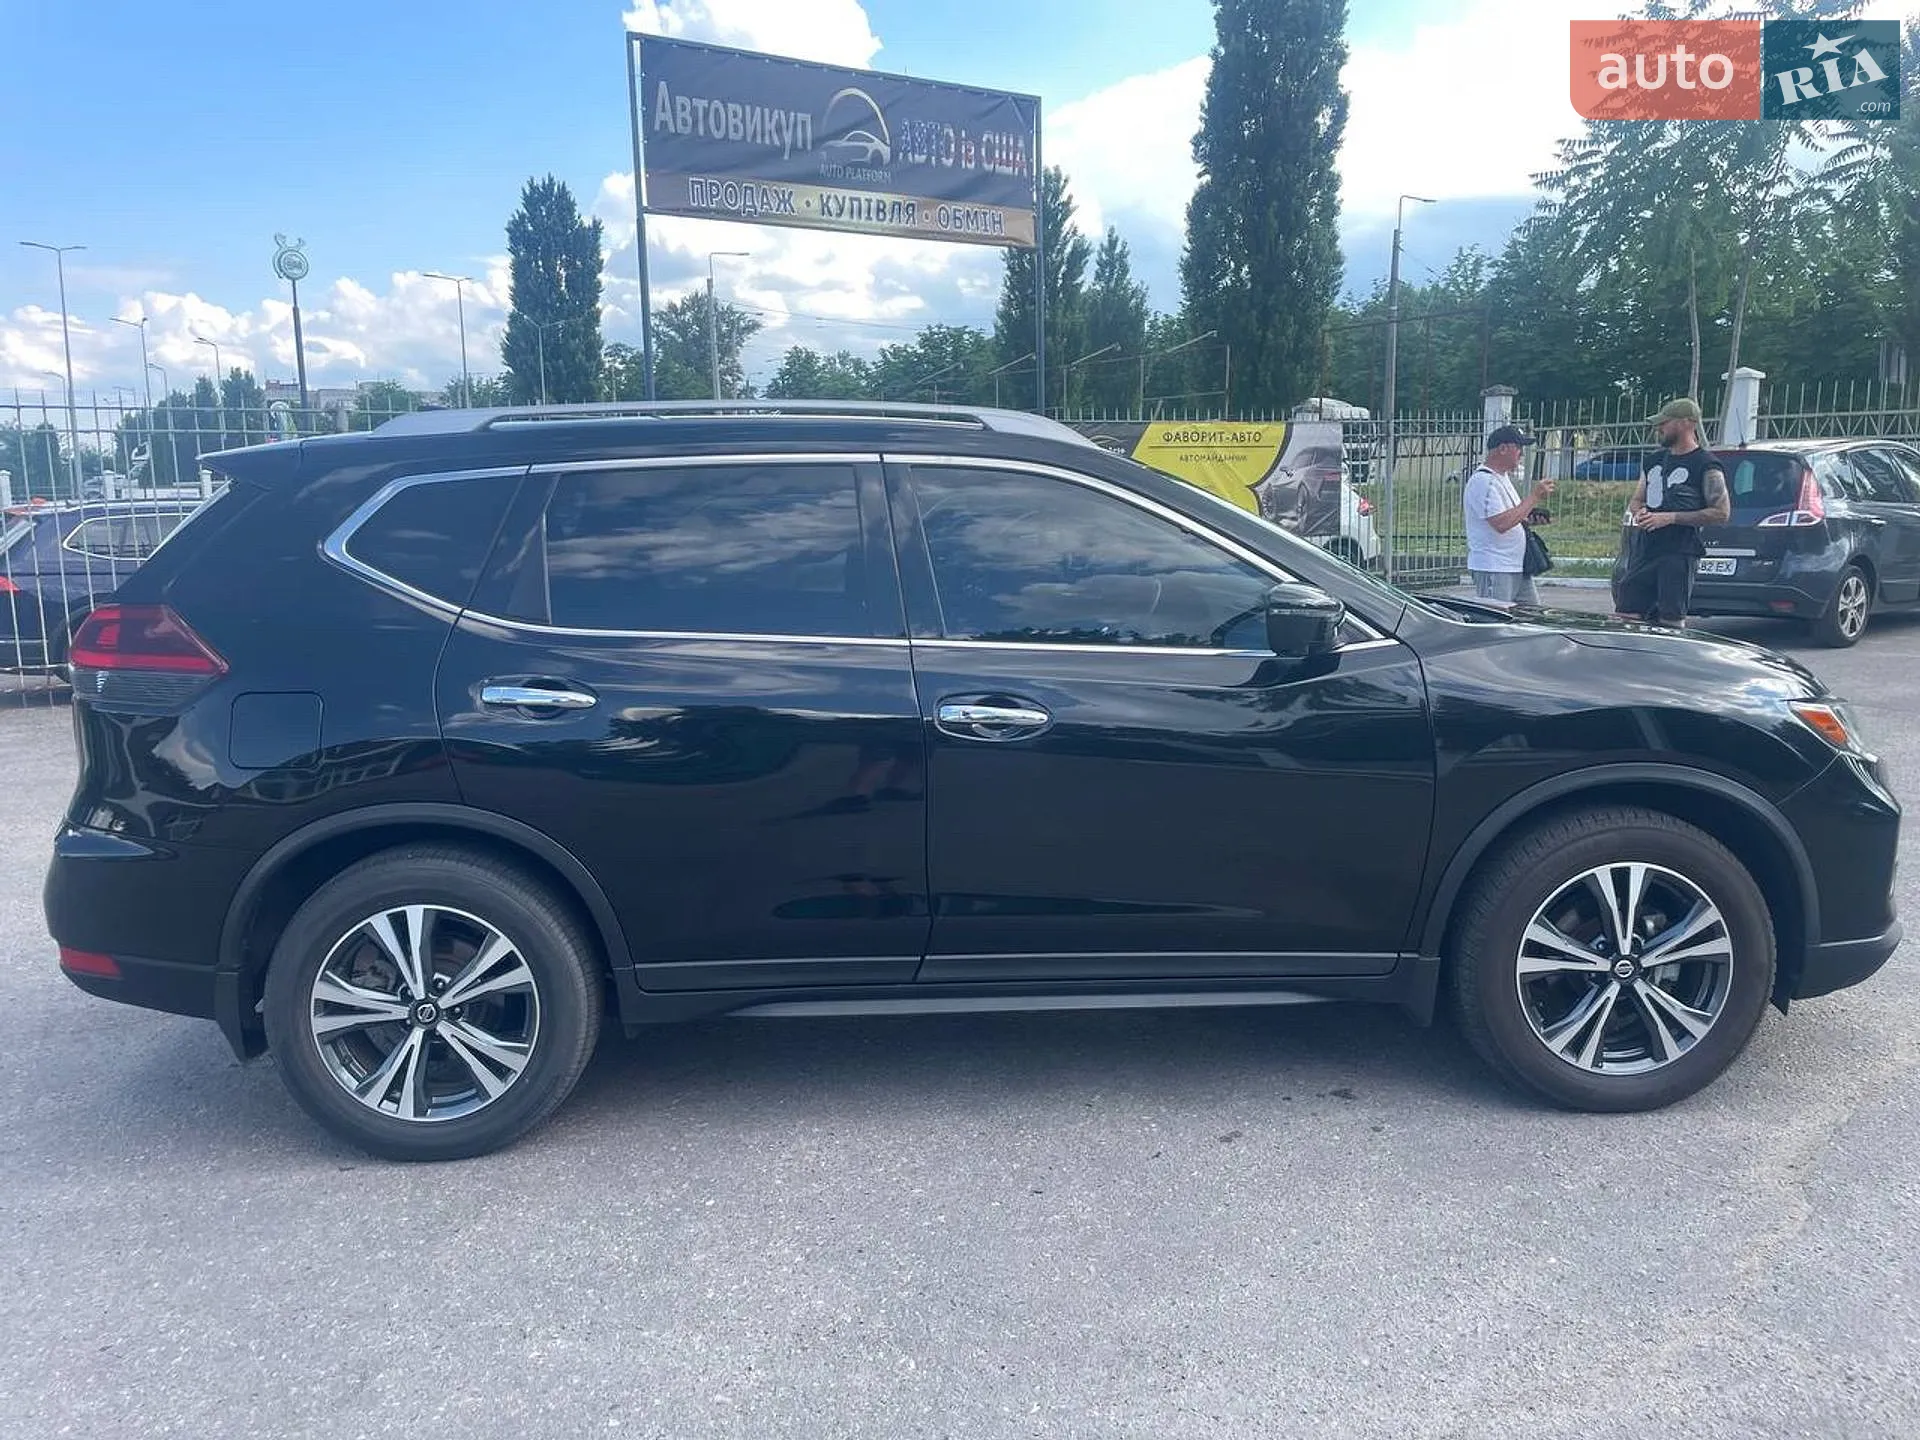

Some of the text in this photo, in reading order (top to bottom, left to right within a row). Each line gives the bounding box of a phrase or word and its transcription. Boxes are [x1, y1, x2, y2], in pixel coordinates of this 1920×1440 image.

[899, 118, 955, 167] АВТО
[981, 131, 1027, 177] США
[820, 163, 844, 178] AUTO
[689, 178, 1004, 235] ПРОДАЖ КУПІВЛЯ ОБМІН
[1162, 431, 1262, 443] ФАВОРИТ-АВТО
